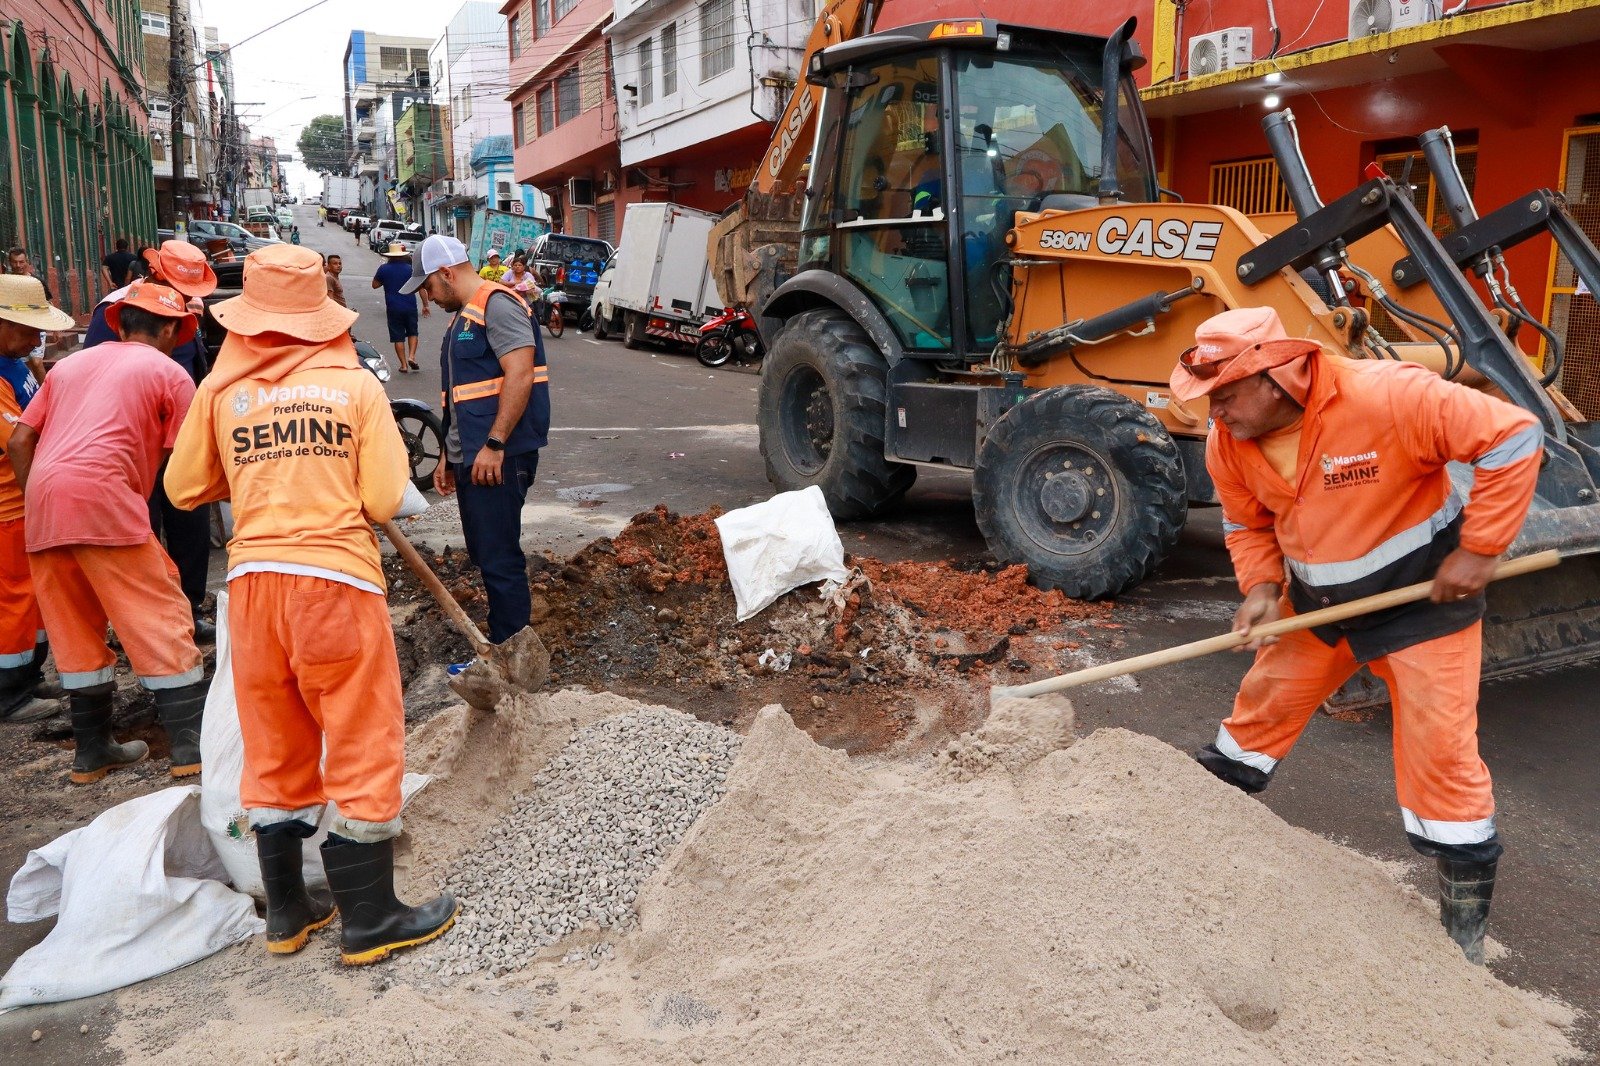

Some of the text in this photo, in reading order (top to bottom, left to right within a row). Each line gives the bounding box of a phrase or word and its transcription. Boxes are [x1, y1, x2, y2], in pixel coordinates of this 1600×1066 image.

[1399, 6, 1410, 16] LG
[769, 84, 814, 177] CASE
[1039, 216, 1224, 262] 580N CASE
[257, 384, 350, 406] Manaus
[273, 402, 333, 416] Prefeitura
[233, 445, 349, 466] Secretaria de Obras
[1334, 451, 1377, 465] Manaus
[1341, 461, 1371, 470] Prefeitura
[1324, 466, 1379, 485] SEMINF
[1324, 482, 1353, 491] Secretaria
